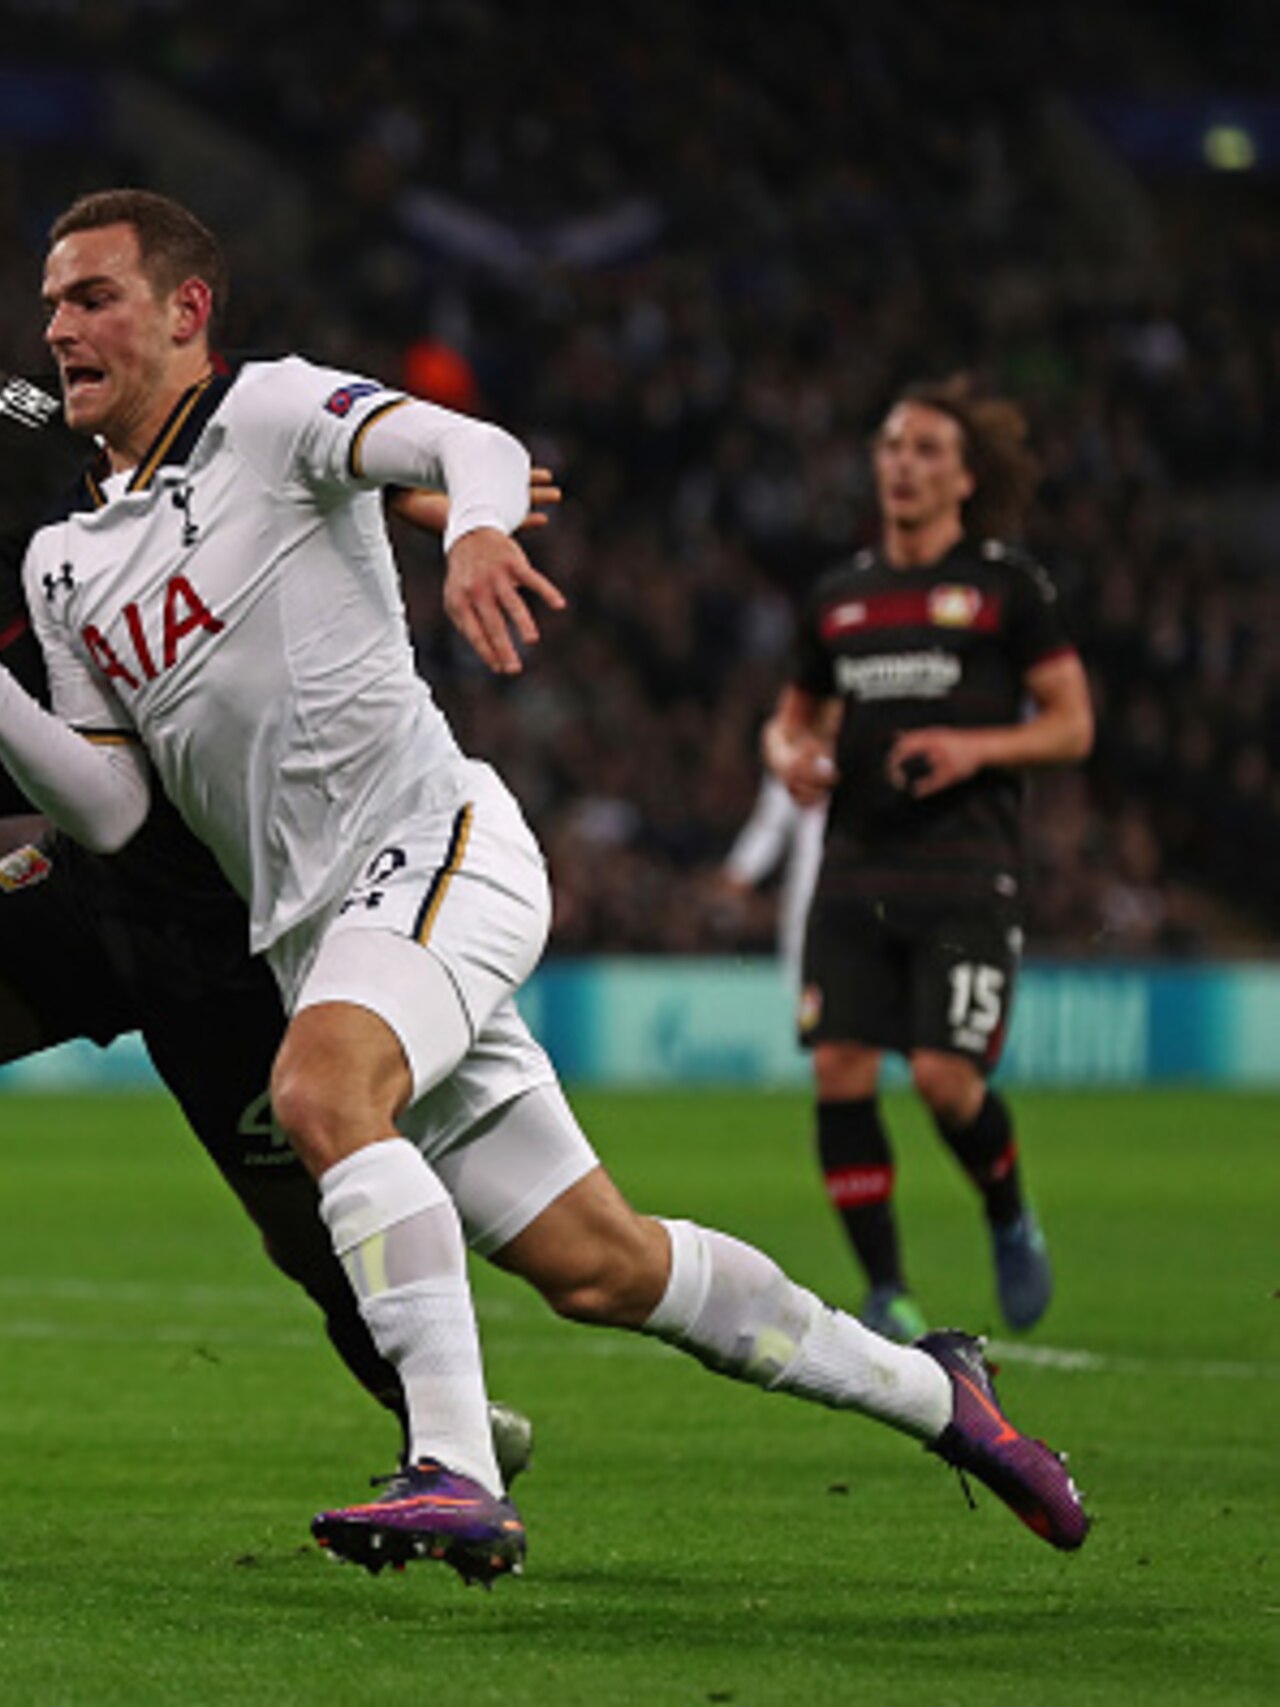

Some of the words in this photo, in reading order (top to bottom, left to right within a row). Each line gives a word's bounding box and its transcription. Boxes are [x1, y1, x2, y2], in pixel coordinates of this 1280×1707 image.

[81, 573, 226, 691] AIA
[948, 962, 1005, 1031] 15
[238, 1088, 287, 1148] 4
